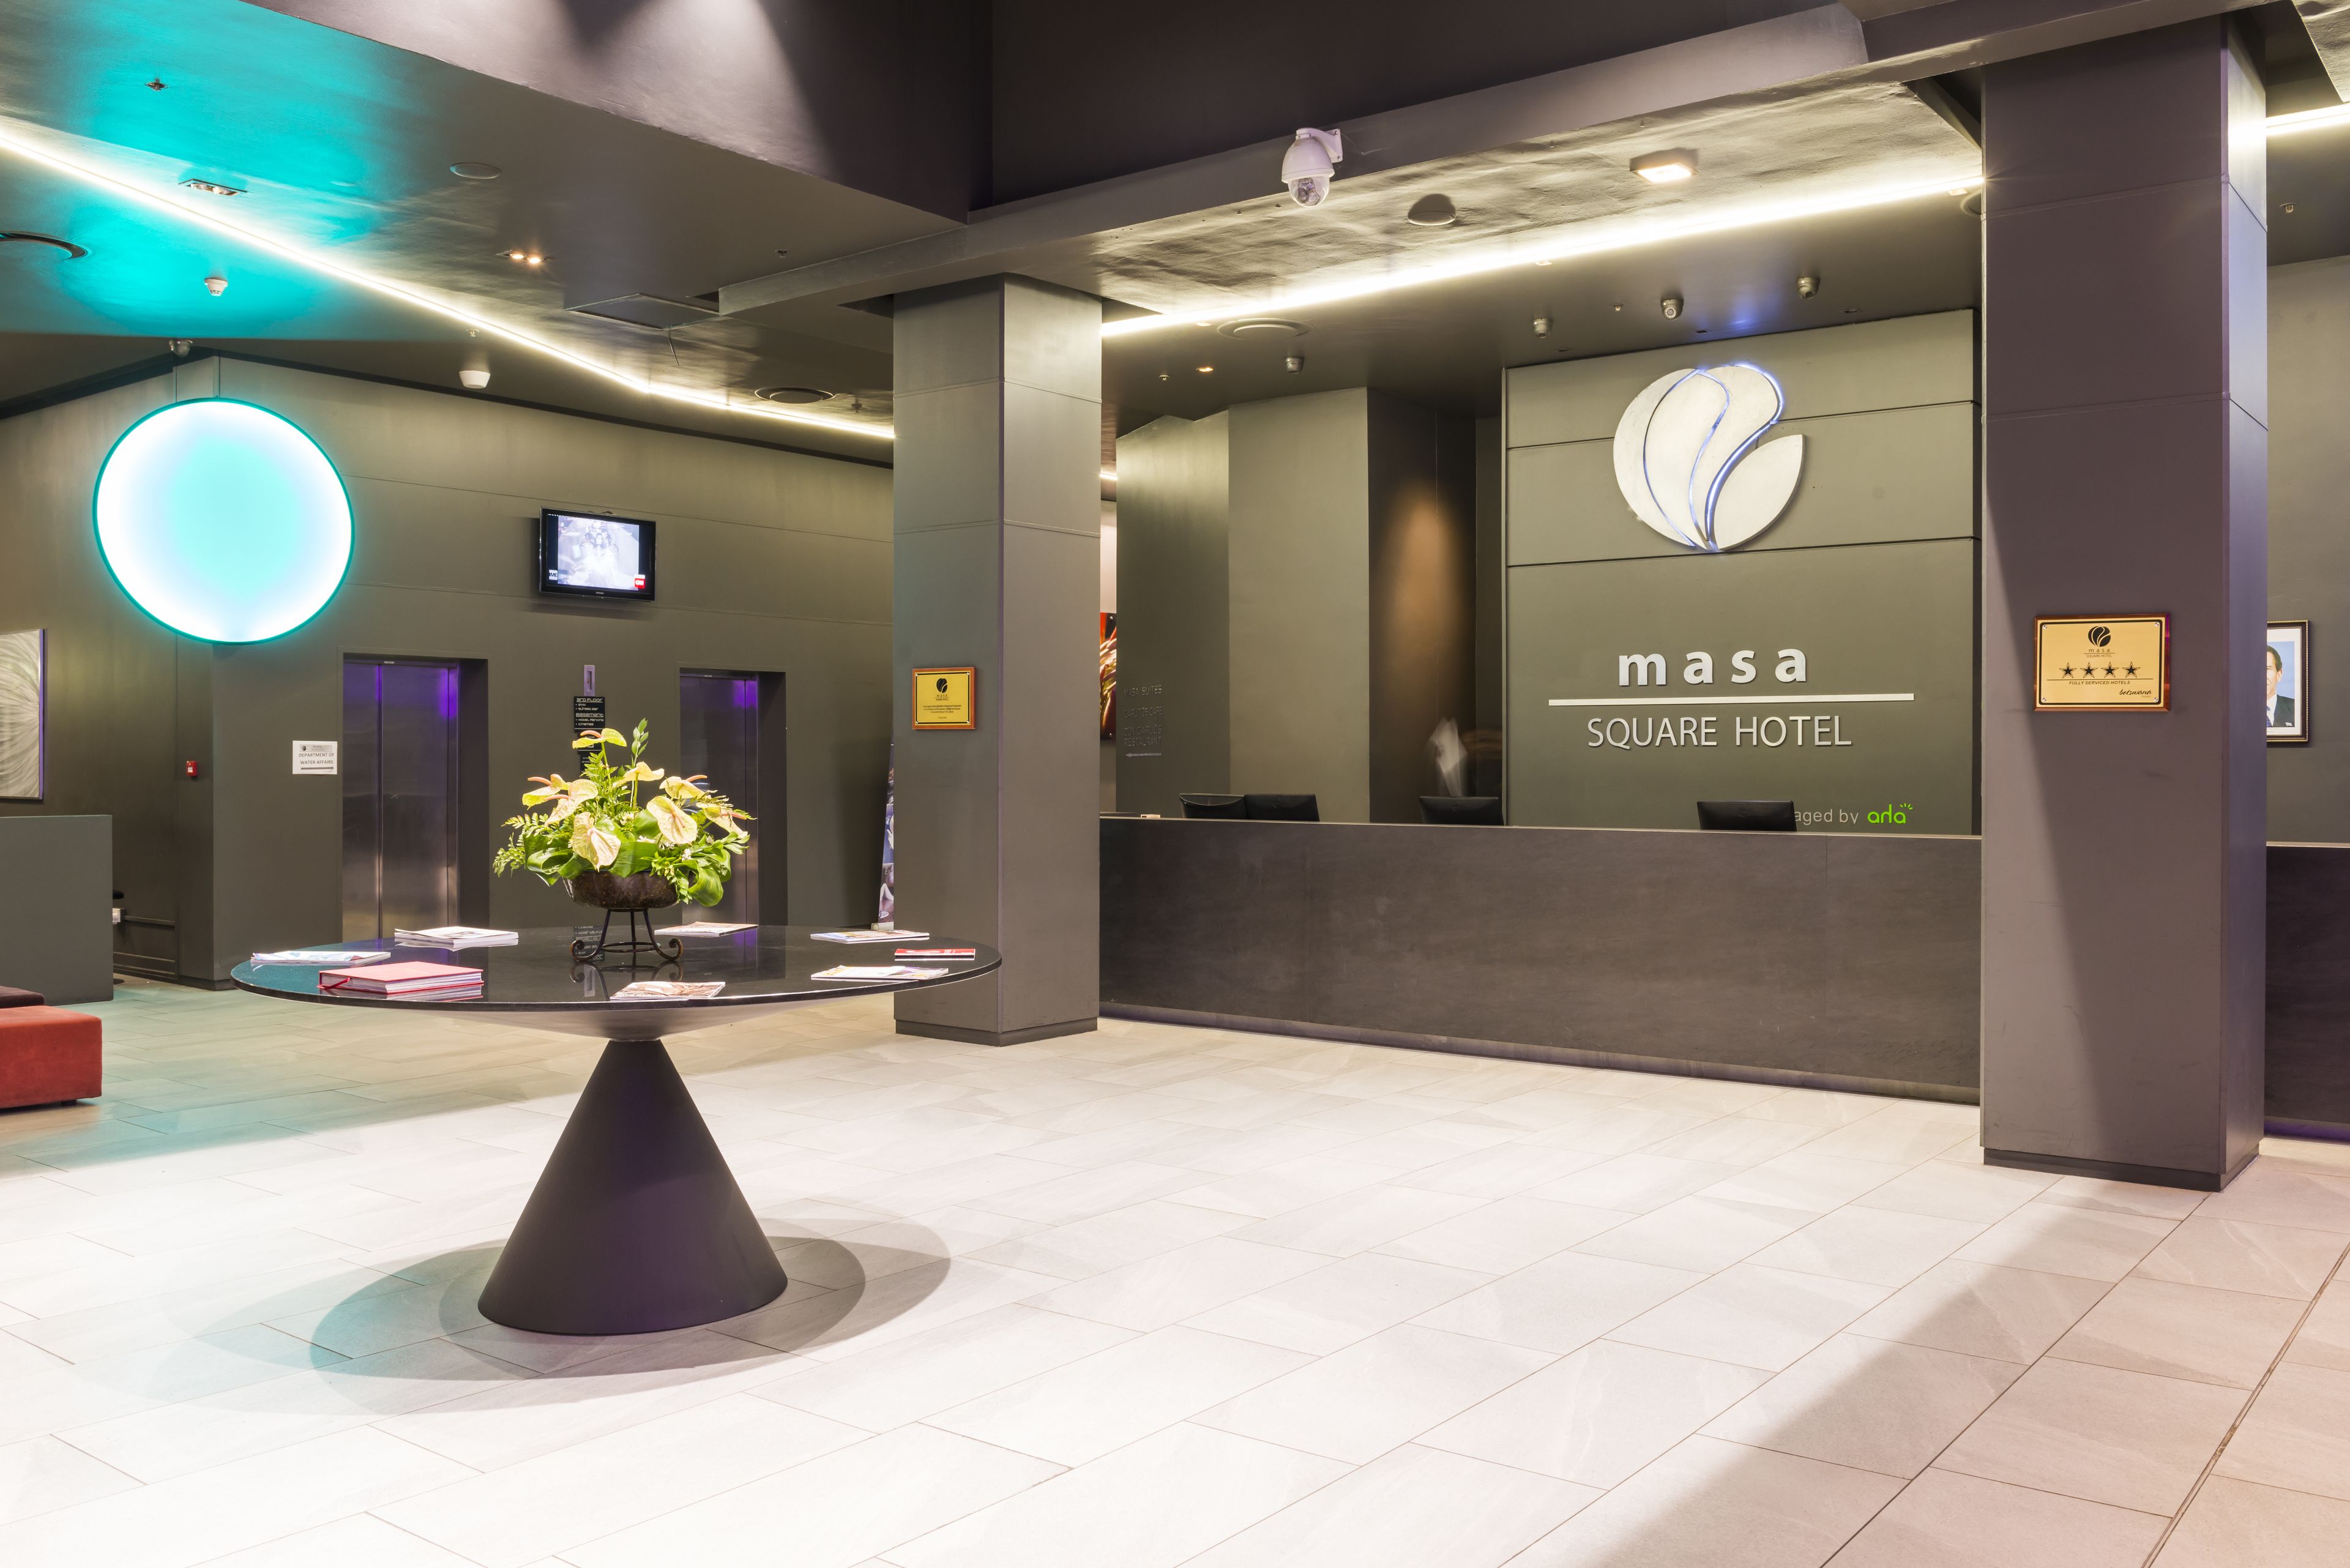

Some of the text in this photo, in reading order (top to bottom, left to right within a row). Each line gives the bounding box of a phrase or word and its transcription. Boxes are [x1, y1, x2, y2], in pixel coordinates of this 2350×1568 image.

[1618, 649, 1807, 687] masa
[1141, 685, 1162, 696] SUITES
[1587, 715, 1852, 750] SQUARE HOTEL
[1794, 808, 1833, 826] aged
[1839, 808, 1859, 825] by
